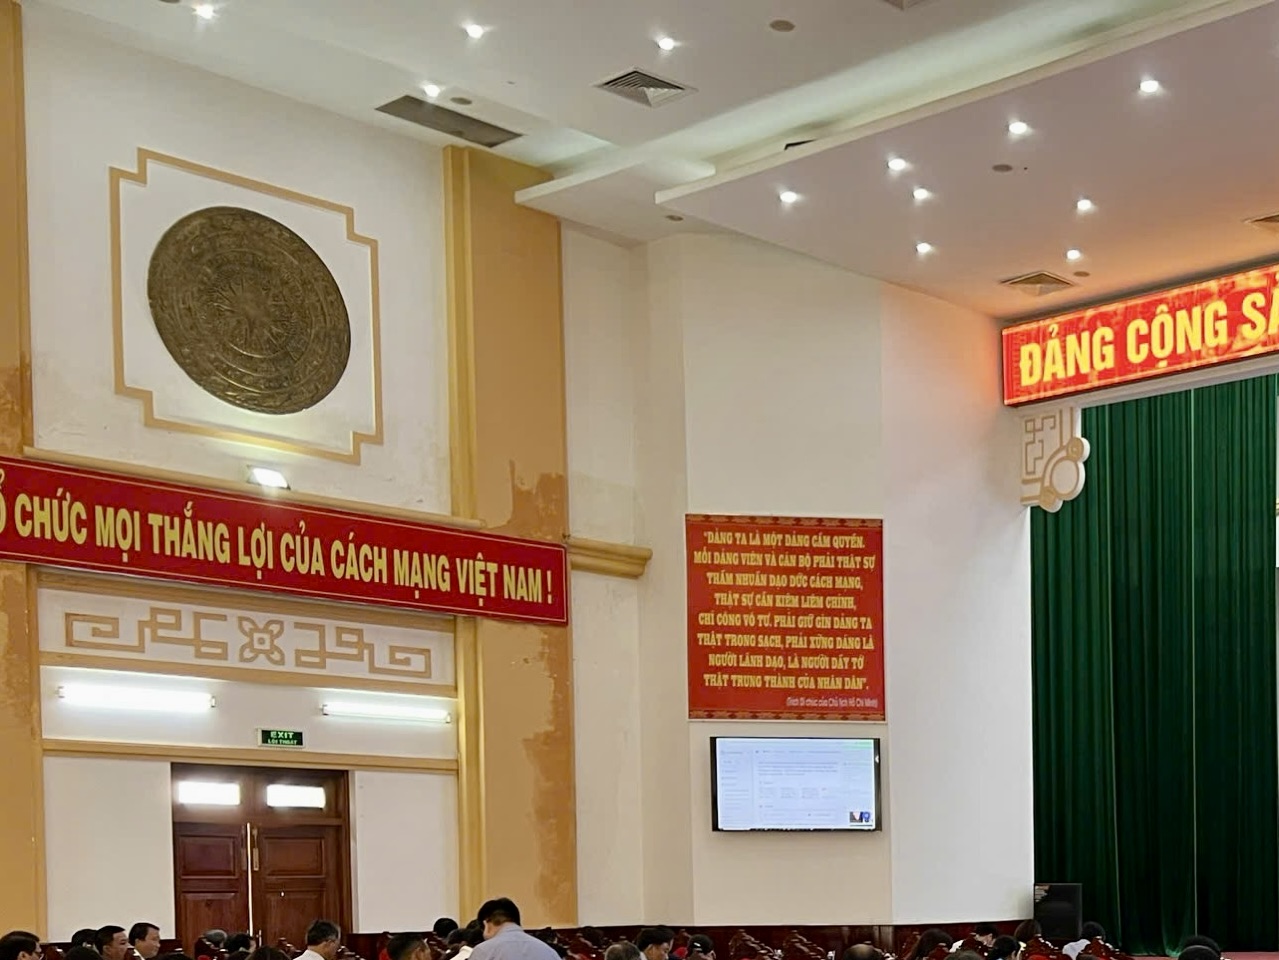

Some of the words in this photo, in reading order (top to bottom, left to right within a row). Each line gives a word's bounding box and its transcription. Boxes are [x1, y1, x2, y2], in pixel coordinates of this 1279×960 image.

[1019, 323, 1115, 388] ĐẢNG
[1125, 307, 1229, 369] CỘNG
[14, 487, 88, 545] CHỨC
[95, 505, 141, 563] MỌI
[148, 501, 230, 564] THẮNG
[238, 522, 274, 580] LỢI
[280, 520, 325, 576] CỦA
[330, 531, 388, 584] CÁCH
[393, 549, 451, 599] MẠNG
[455, 552, 498, 607] VIỆT
[503, 564, 543, 604] NAM
[860, 617, 873, 630] TA
[724, 633, 756, 647] TRONG
[730, 674, 762, 687] TRUNG
[270, 731, 294, 739] EXIT
